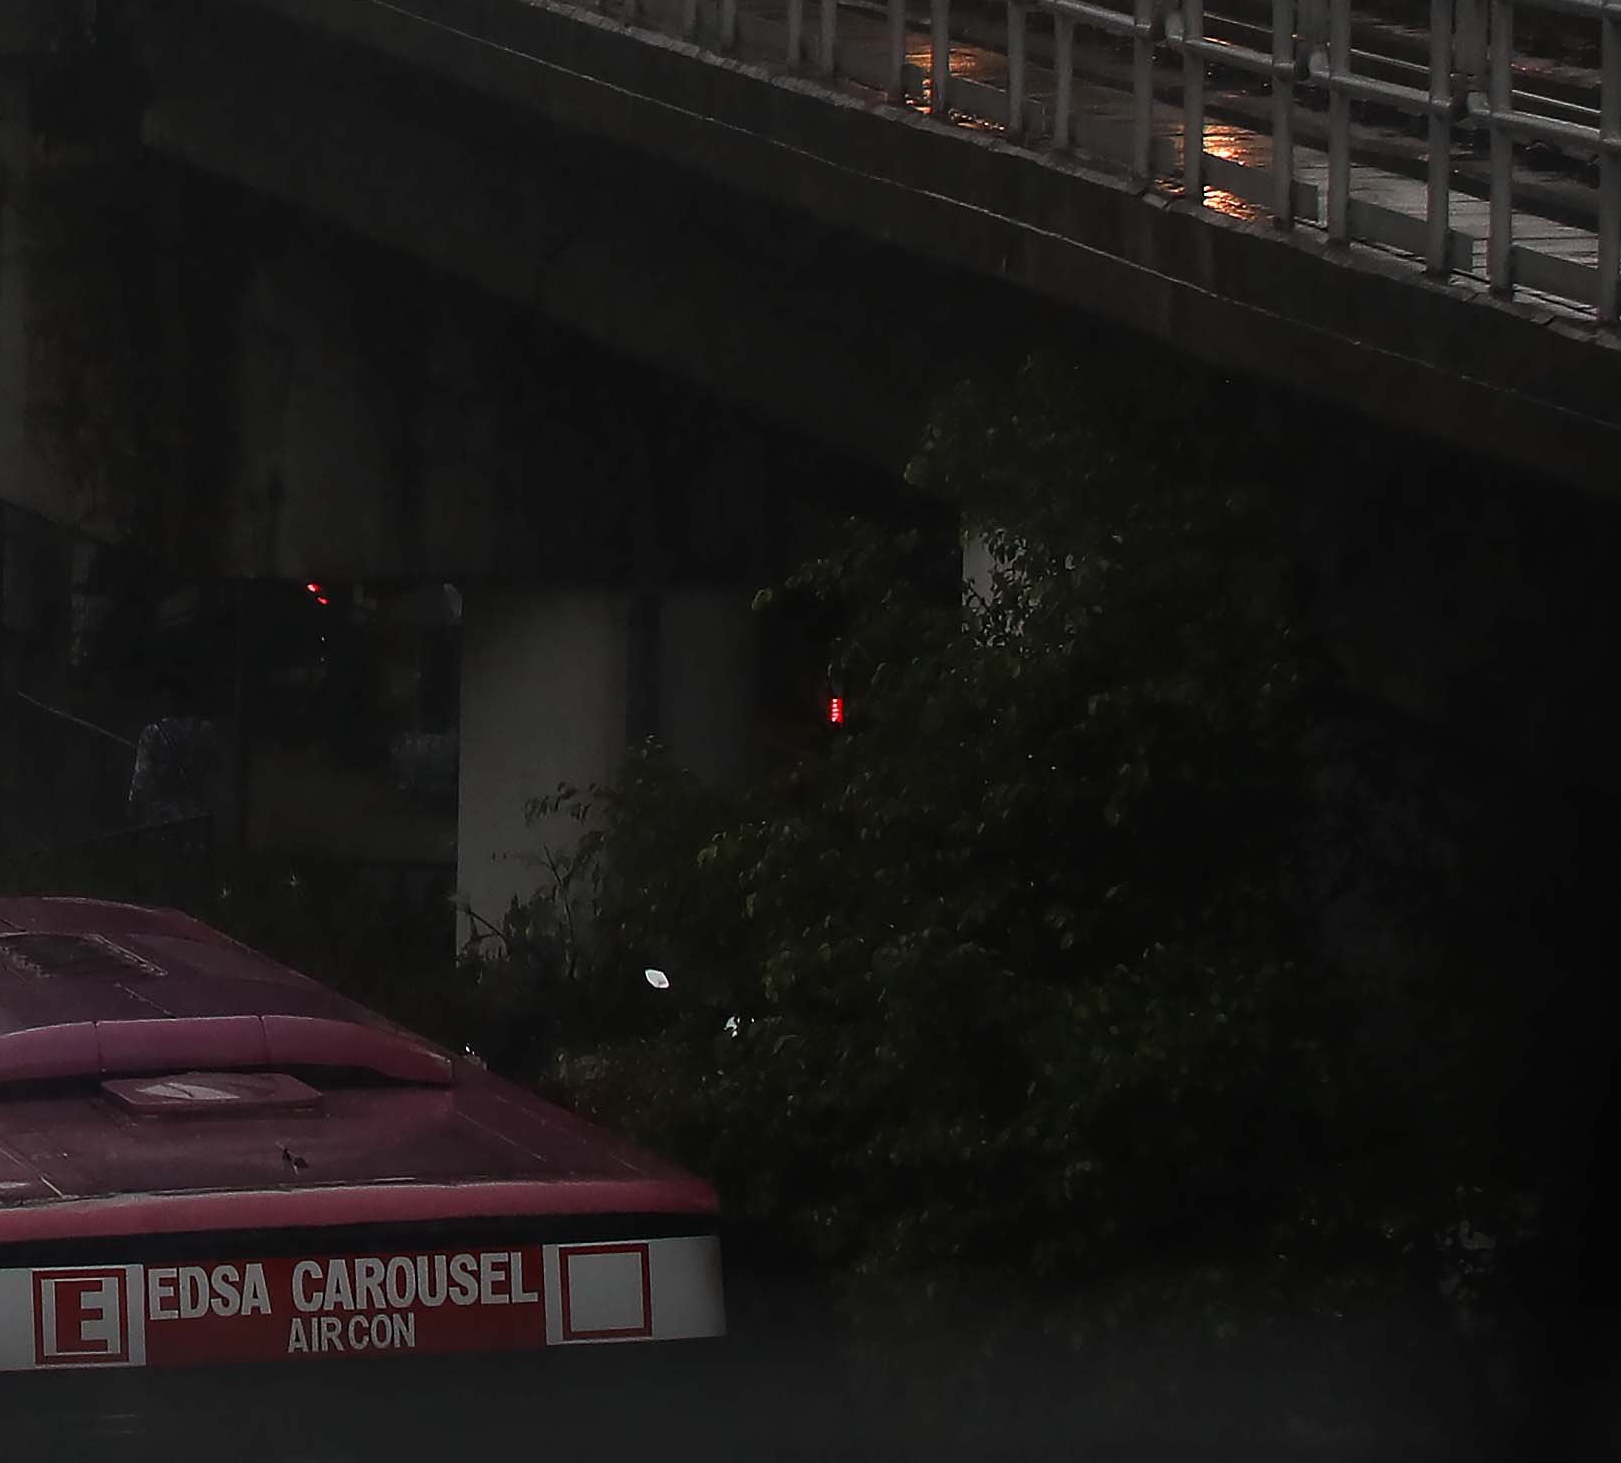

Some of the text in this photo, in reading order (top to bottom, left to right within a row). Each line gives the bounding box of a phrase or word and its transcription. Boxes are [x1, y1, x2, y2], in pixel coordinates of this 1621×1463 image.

[53, 1250, 539, 1355] E EDSA CAROUSEL
[287, 1311, 418, 1354] AIRCON
